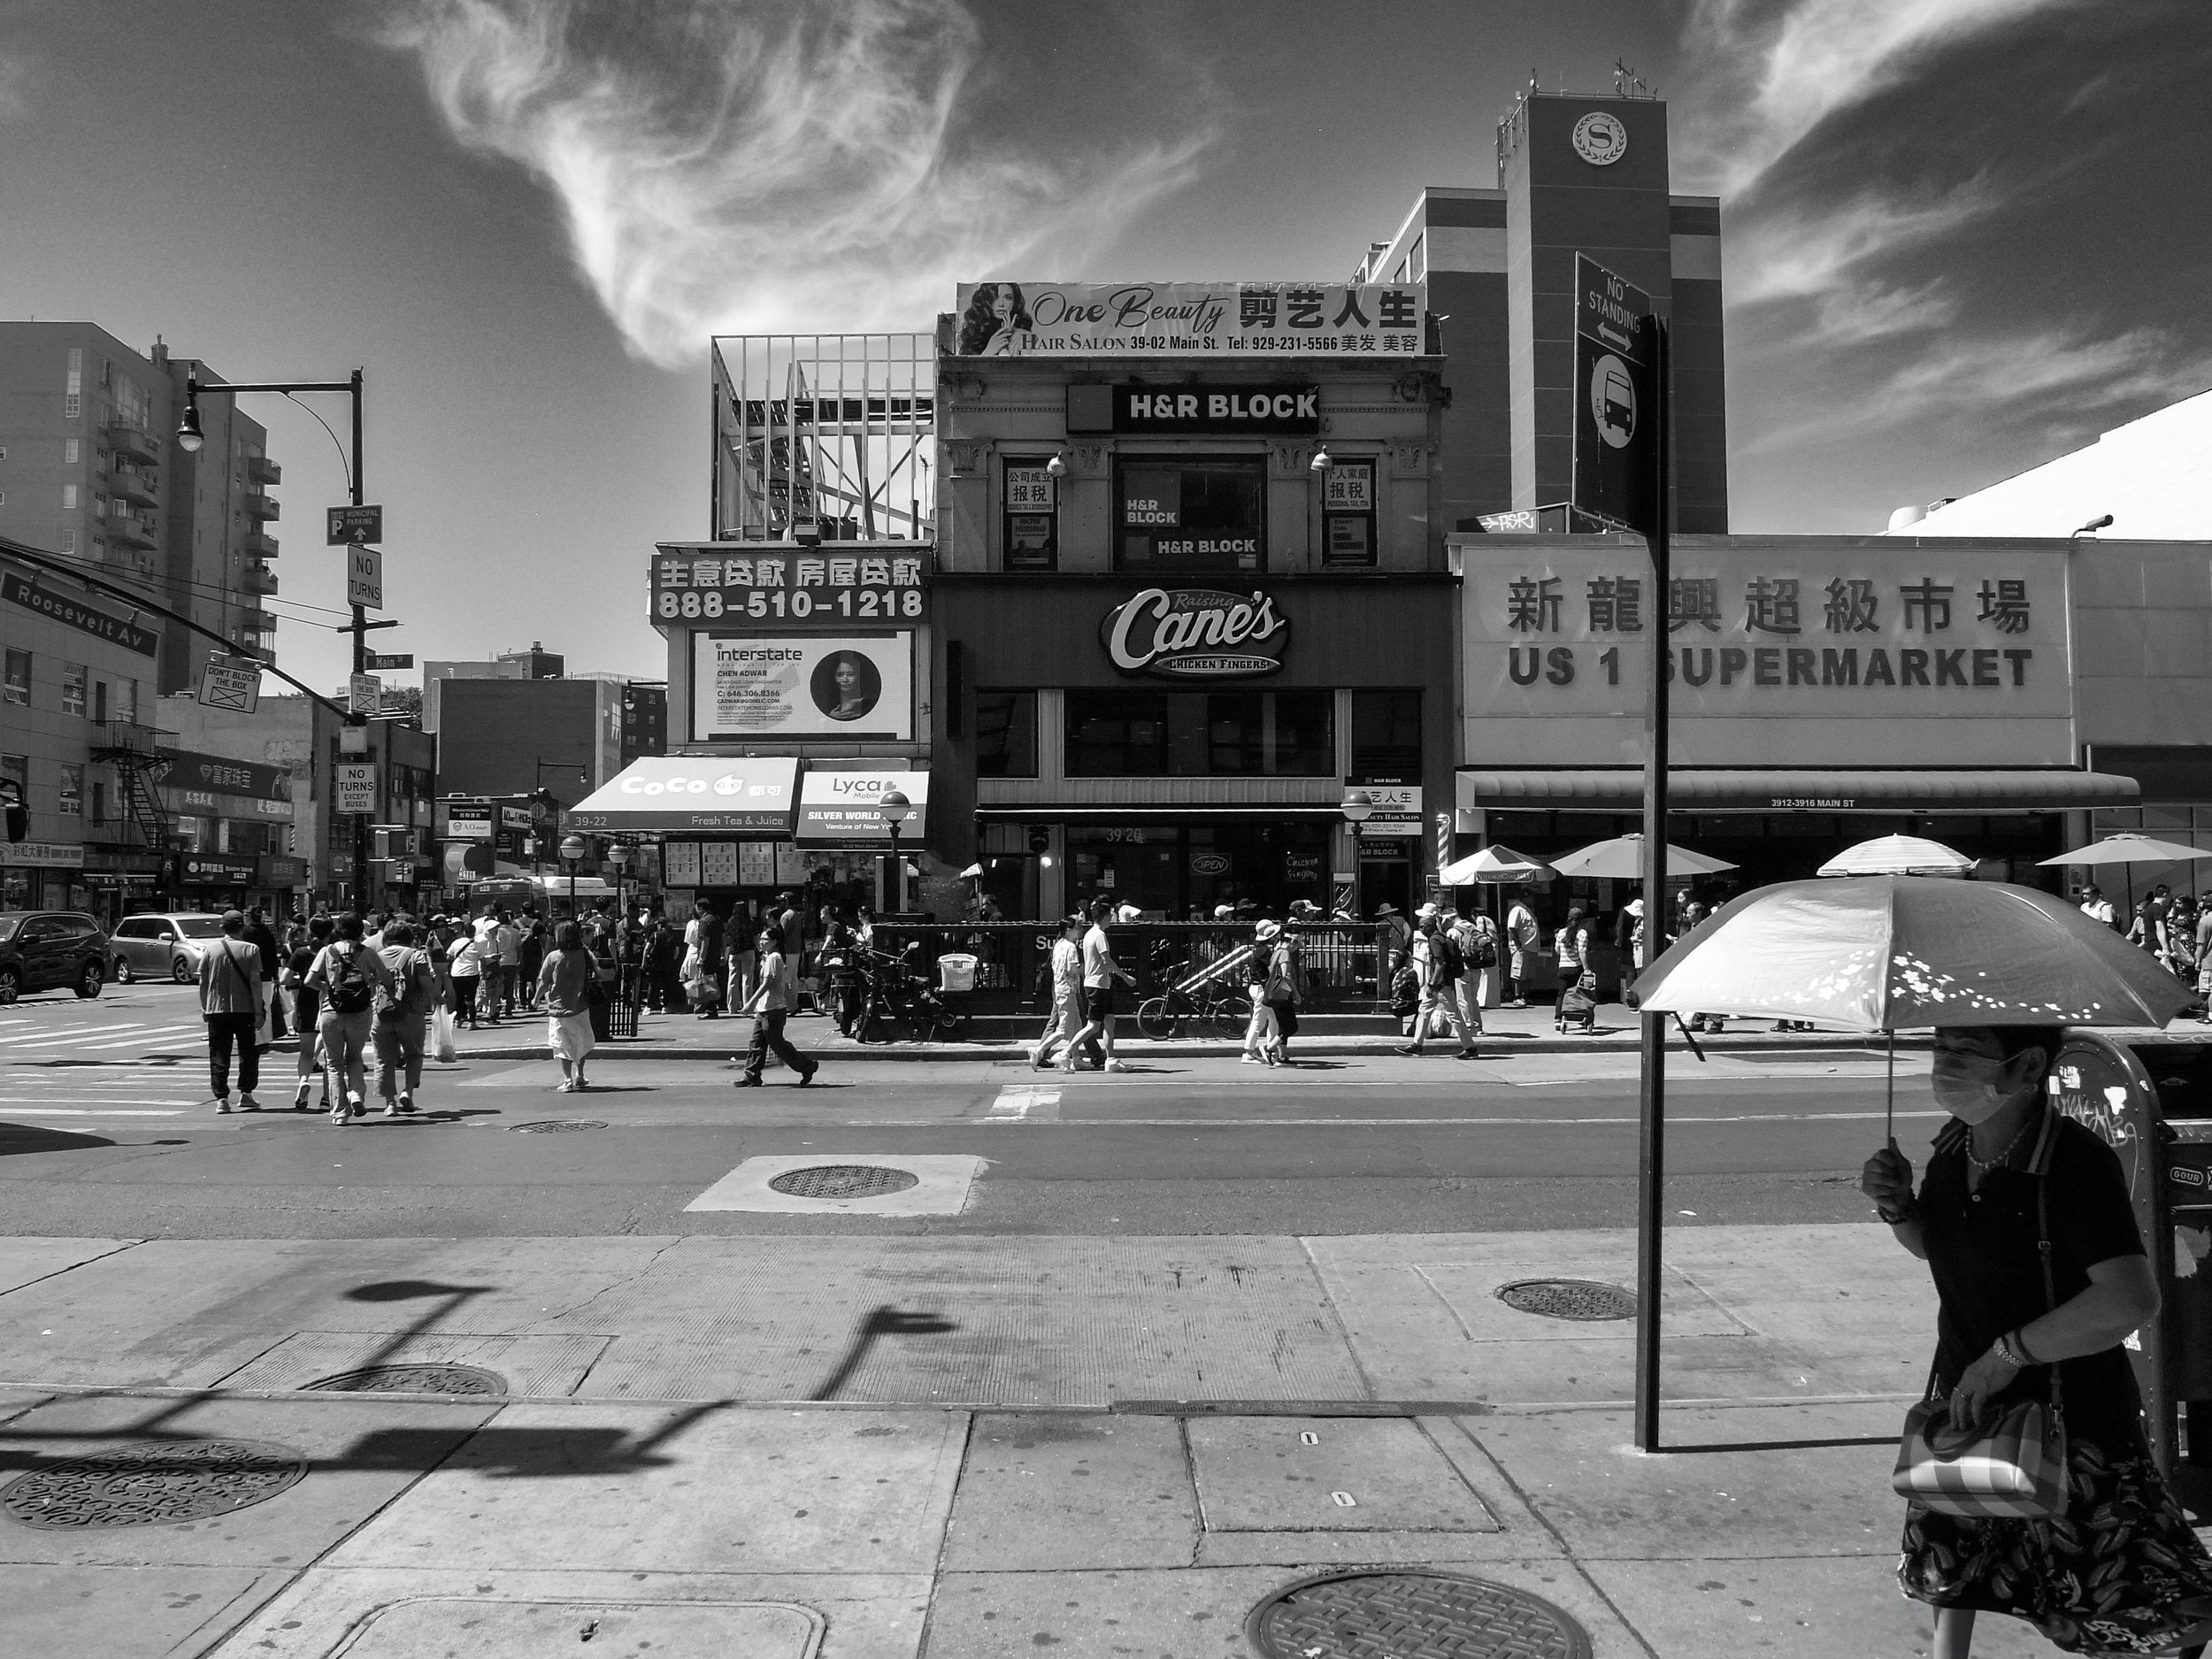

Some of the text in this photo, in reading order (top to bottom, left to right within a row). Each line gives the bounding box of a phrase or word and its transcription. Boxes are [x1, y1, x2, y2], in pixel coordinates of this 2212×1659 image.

[1587, 123, 1613, 150] S
[1607, 277, 1624, 301] NO
[1032, 288, 1232, 333] One Beauty
[1240, 290, 1417, 328] 剪艺人生
[1589, 290, 1641, 334] STANDING
[1131, 335, 1165, 350] 39-02
[1170, 335, 1199, 349] Main
[1203, 335, 1219, 350] St.
[1227, 335, 1248, 350] Tel:
[1252, 335, 1338, 350] 929-231-5566
[1341, 334, 1417, 351] 美发 美容
[1130, 395, 1317, 418] H&R BLOCK
[1010, 472, 1052, 483] 公司成立
[1012, 485, 1047, 502] 报税
[1330, 481, 1363, 499] 报税
[1127, 499, 1158, 511] H&R
[1127, 511, 1176, 524] BLOCK
[331, 519, 343, 536] P
[1158, 539, 1256, 554] H&R BLOCK
[356, 555, 373, 576] NO
[660, 558, 922, 588] 生意贷款 房屋贷款
[349, 580, 380, 601] TURNS
[658, 589, 923, 618] 888-510-1218
[1173, 594, 1234, 611] Raising
[1508, 575, 2031, 634] 新龍興超級市場
[18, 584, 142, 647] Roosevelt Av
[1110, 588, 1286, 669] Cane's
[717, 647, 803, 661] interstate
[376, 657, 395, 668] Main
[1169, 659, 1268, 670] CHICKEN FINGERS
[1509, 646, 1575, 687] US
[1600, 647, 1618, 686] 1
[208, 667, 257, 682] DON'T BLOCK
[216, 678, 248, 690] THE BOX
[348, 769, 365, 779] NO
[339, 782, 374, 791] TURNS
[620, 776, 707, 795] CoCo
[748, 785, 782, 796] 都可
[833, 778, 881, 794] Lyca
[1364, 790, 1412, 803] 艺人生
[1816, 799, 1840, 808] MAIN
[1842, 799, 1855, 808] ST
[575, 815, 784, 826] 39-22 Fresh Tea & Juice
[808, 811, 842, 820] SILVER
[845, 811, 881, 820] WORLD
[1199, 860, 1225, 870] OPEN
[2173, 1171, 2200, 1183] GOUR
